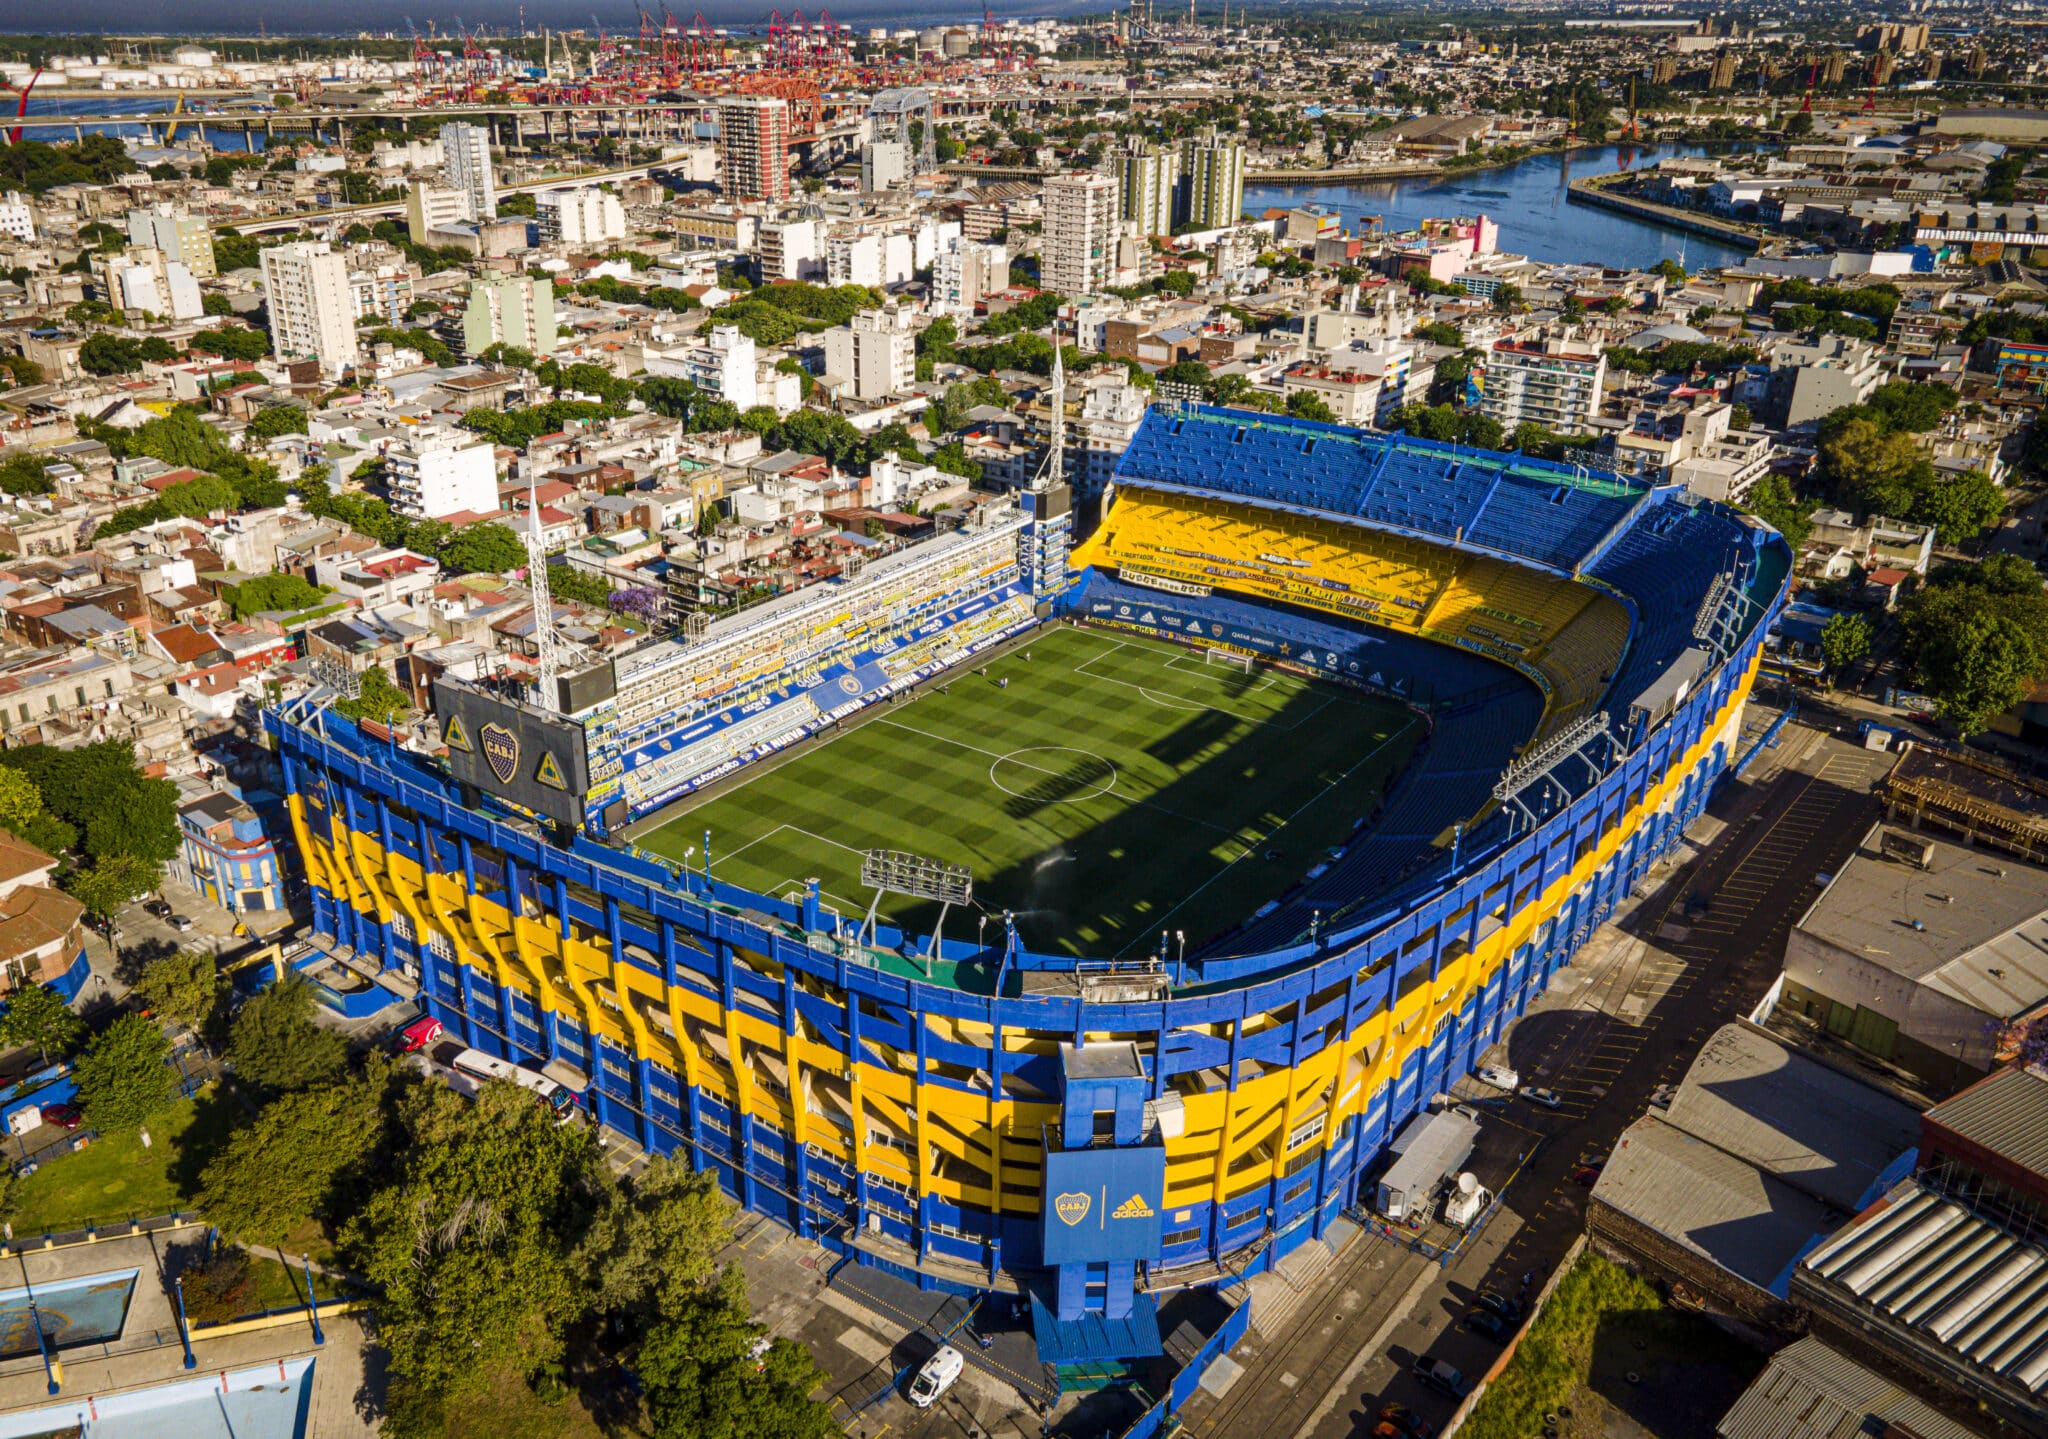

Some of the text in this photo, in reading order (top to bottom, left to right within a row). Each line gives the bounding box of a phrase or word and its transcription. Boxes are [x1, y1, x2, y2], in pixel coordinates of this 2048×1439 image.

[1231, 632, 1250, 641] QATAR
[755, 743, 772, 756] LA
[770, 725, 808, 750] NUEVA
[817, 712, 834, 726] LA
[832, 698, 867, 719] NUEVA
[875, 686, 892, 698] LA
[888, 673, 921, 691] NUEVA
[929, 659, 943, 672] LA
[941, 649, 973, 667] NUEVA
[486, 741, 514, 760] CABJ
[1060, 1202, 1086, 1211] CABJ
[1112, 1208, 1155, 1218] adidas
